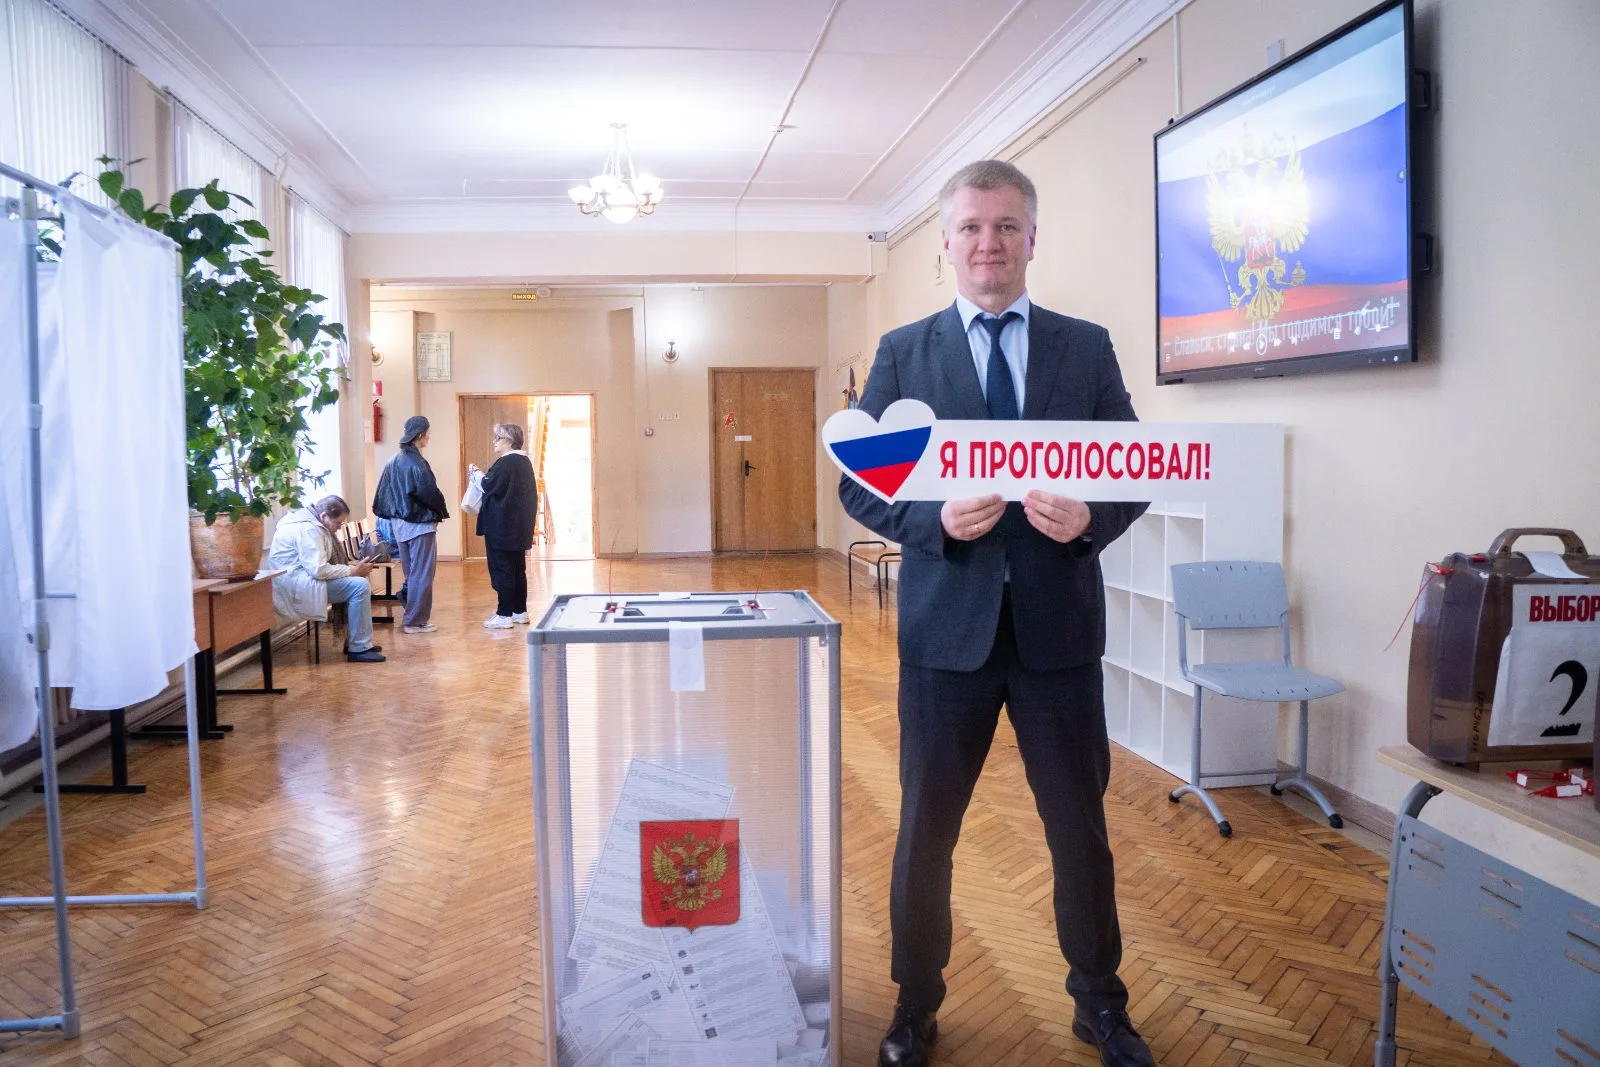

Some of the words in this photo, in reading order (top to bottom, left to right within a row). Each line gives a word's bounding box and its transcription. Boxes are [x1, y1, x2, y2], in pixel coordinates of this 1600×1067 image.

[940, 440, 958, 478] Я
[969, 440, 1211, 481] ПРОГОЛОСОВАЛ!
[1540, 660, 1588, 737] 2
